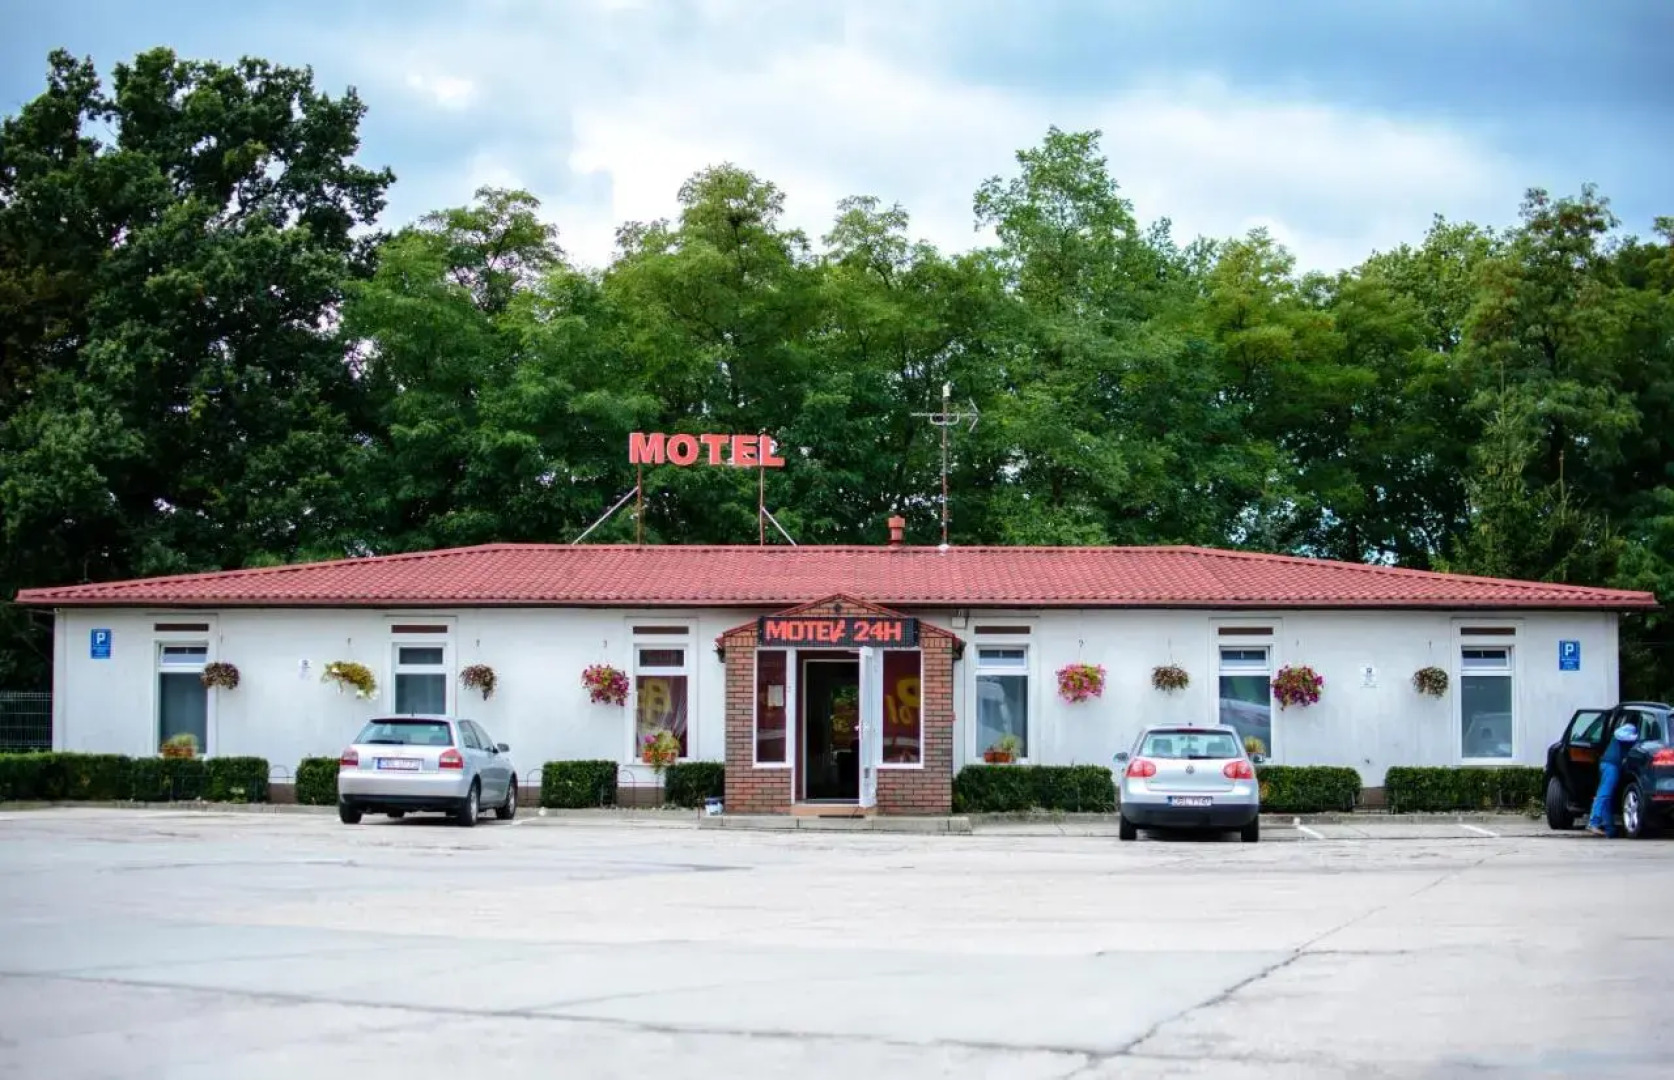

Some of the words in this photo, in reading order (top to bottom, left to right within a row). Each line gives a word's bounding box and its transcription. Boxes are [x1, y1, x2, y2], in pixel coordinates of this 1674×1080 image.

[629, 432, 785, 467] MOTEL
[96, 632, 107, 645] P
[853, 620, 902, 642] 24H
[1564, 643, 1575, 656] P
